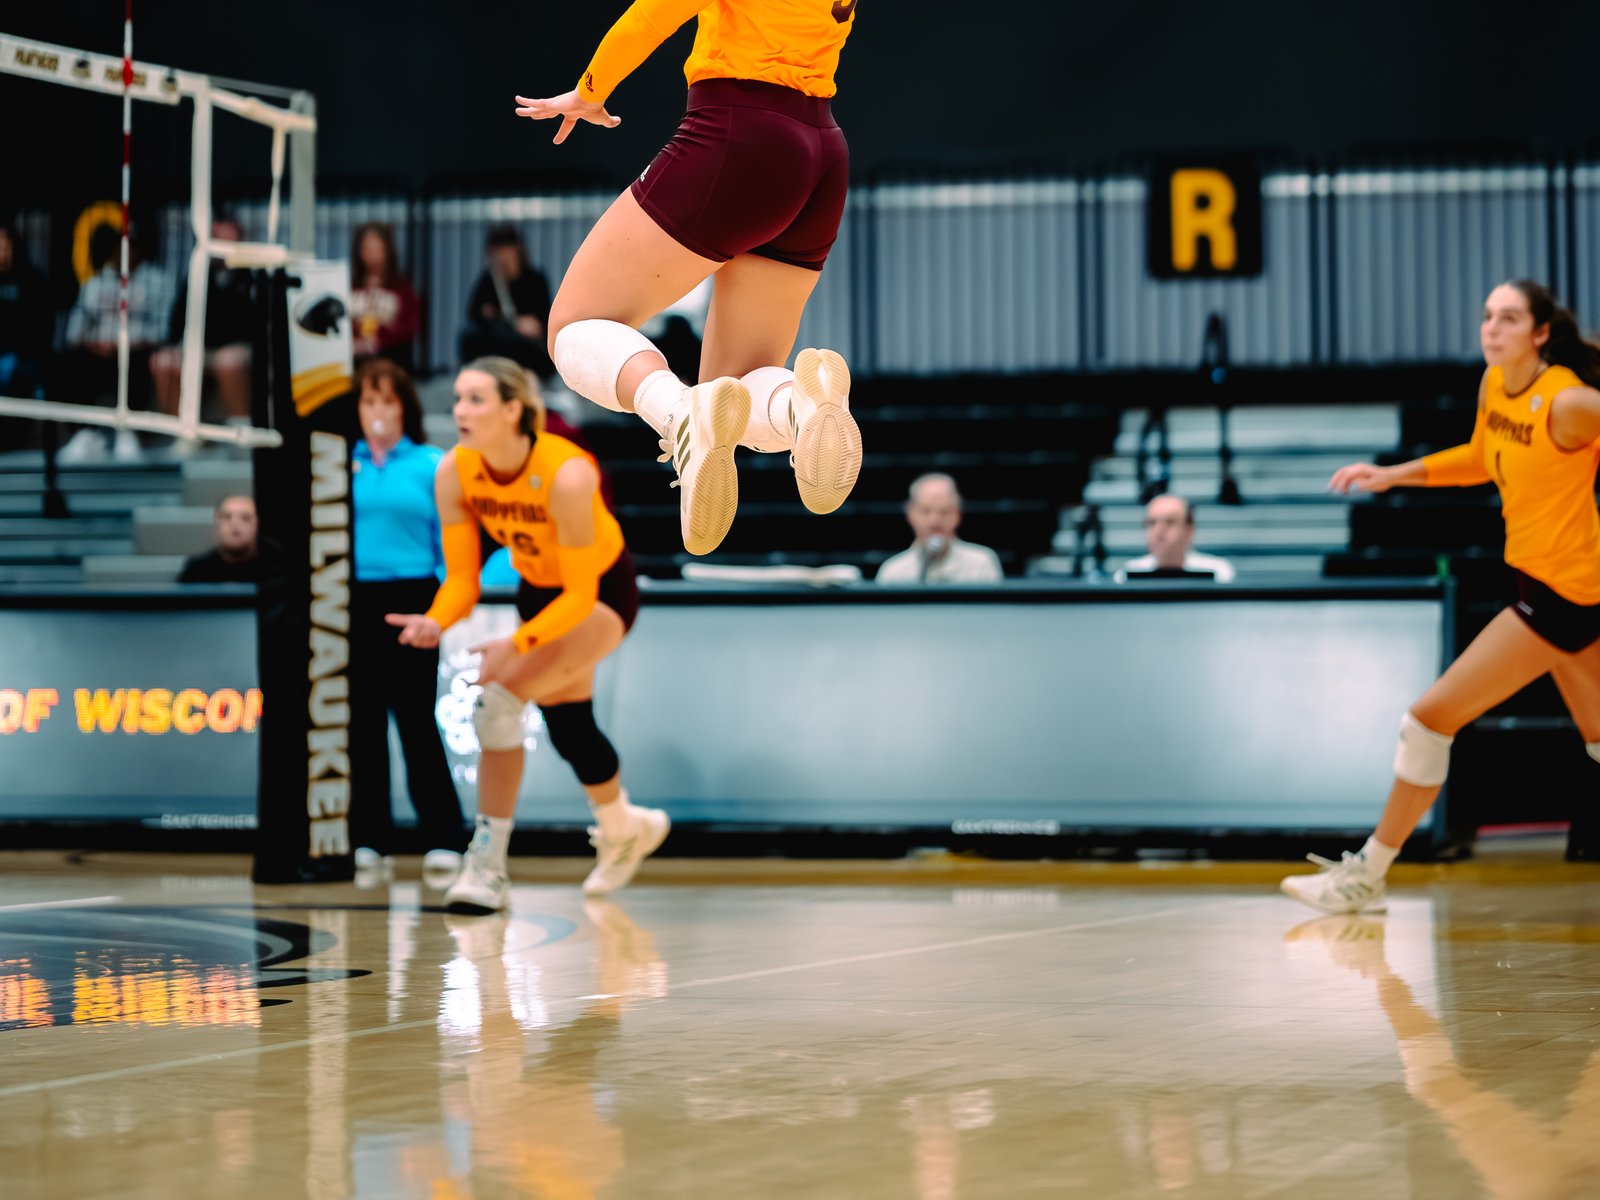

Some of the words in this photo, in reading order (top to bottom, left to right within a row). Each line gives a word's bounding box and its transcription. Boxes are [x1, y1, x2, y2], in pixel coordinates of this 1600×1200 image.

[1170, 167, 1237, 272] R
[307, 430, 351, 858] MILWAUKEE
[0, 687, 59, 735] OF
